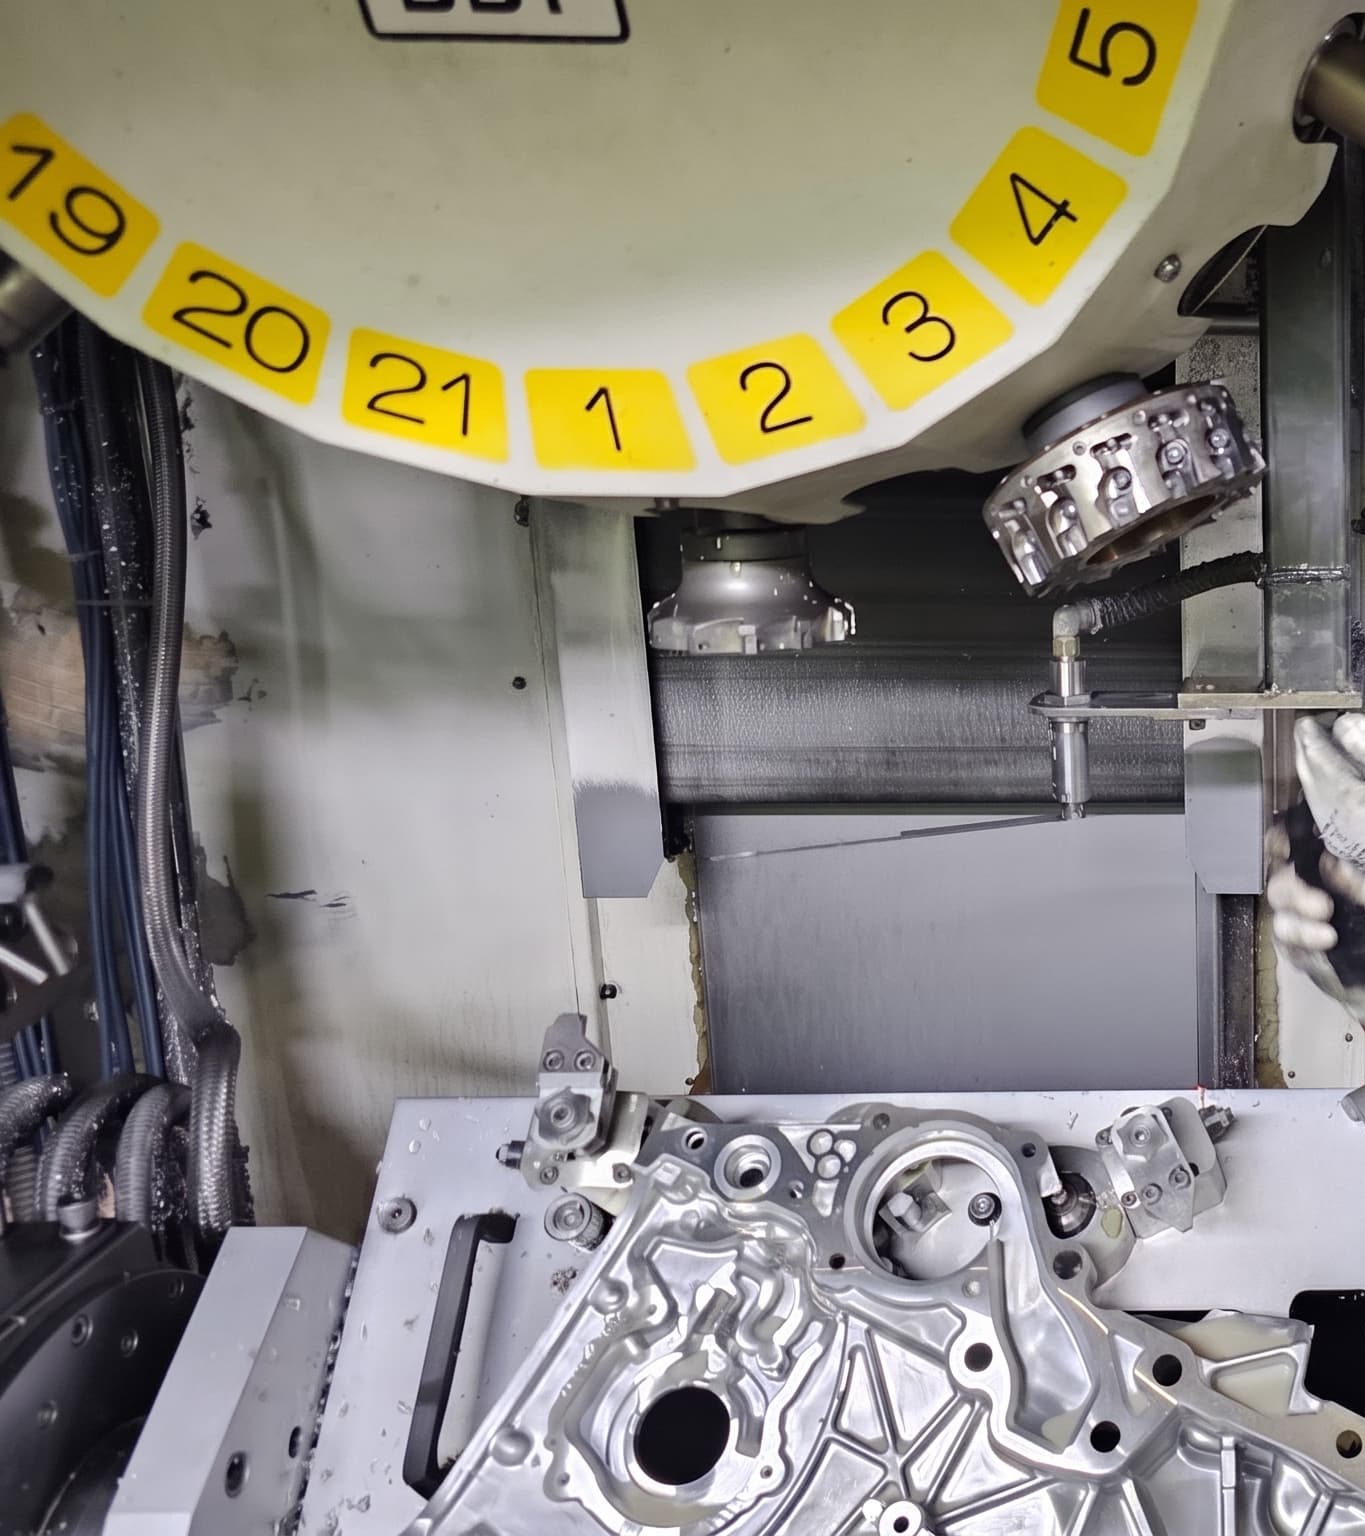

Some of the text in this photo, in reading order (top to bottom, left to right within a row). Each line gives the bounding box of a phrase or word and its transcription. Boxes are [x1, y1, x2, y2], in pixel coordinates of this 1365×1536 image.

[1068, 7, 1157, 87] 5
[7, 144, 126, 256] 19
[1009, 172, 1078, 246] 4
[172, 270, 310, 373] 20
[882, 291, 956, 362] 3
[367, 352, 472, 437] 21
[584, 387, 623, 451] 1
[739, 362, 813, 434] 2
